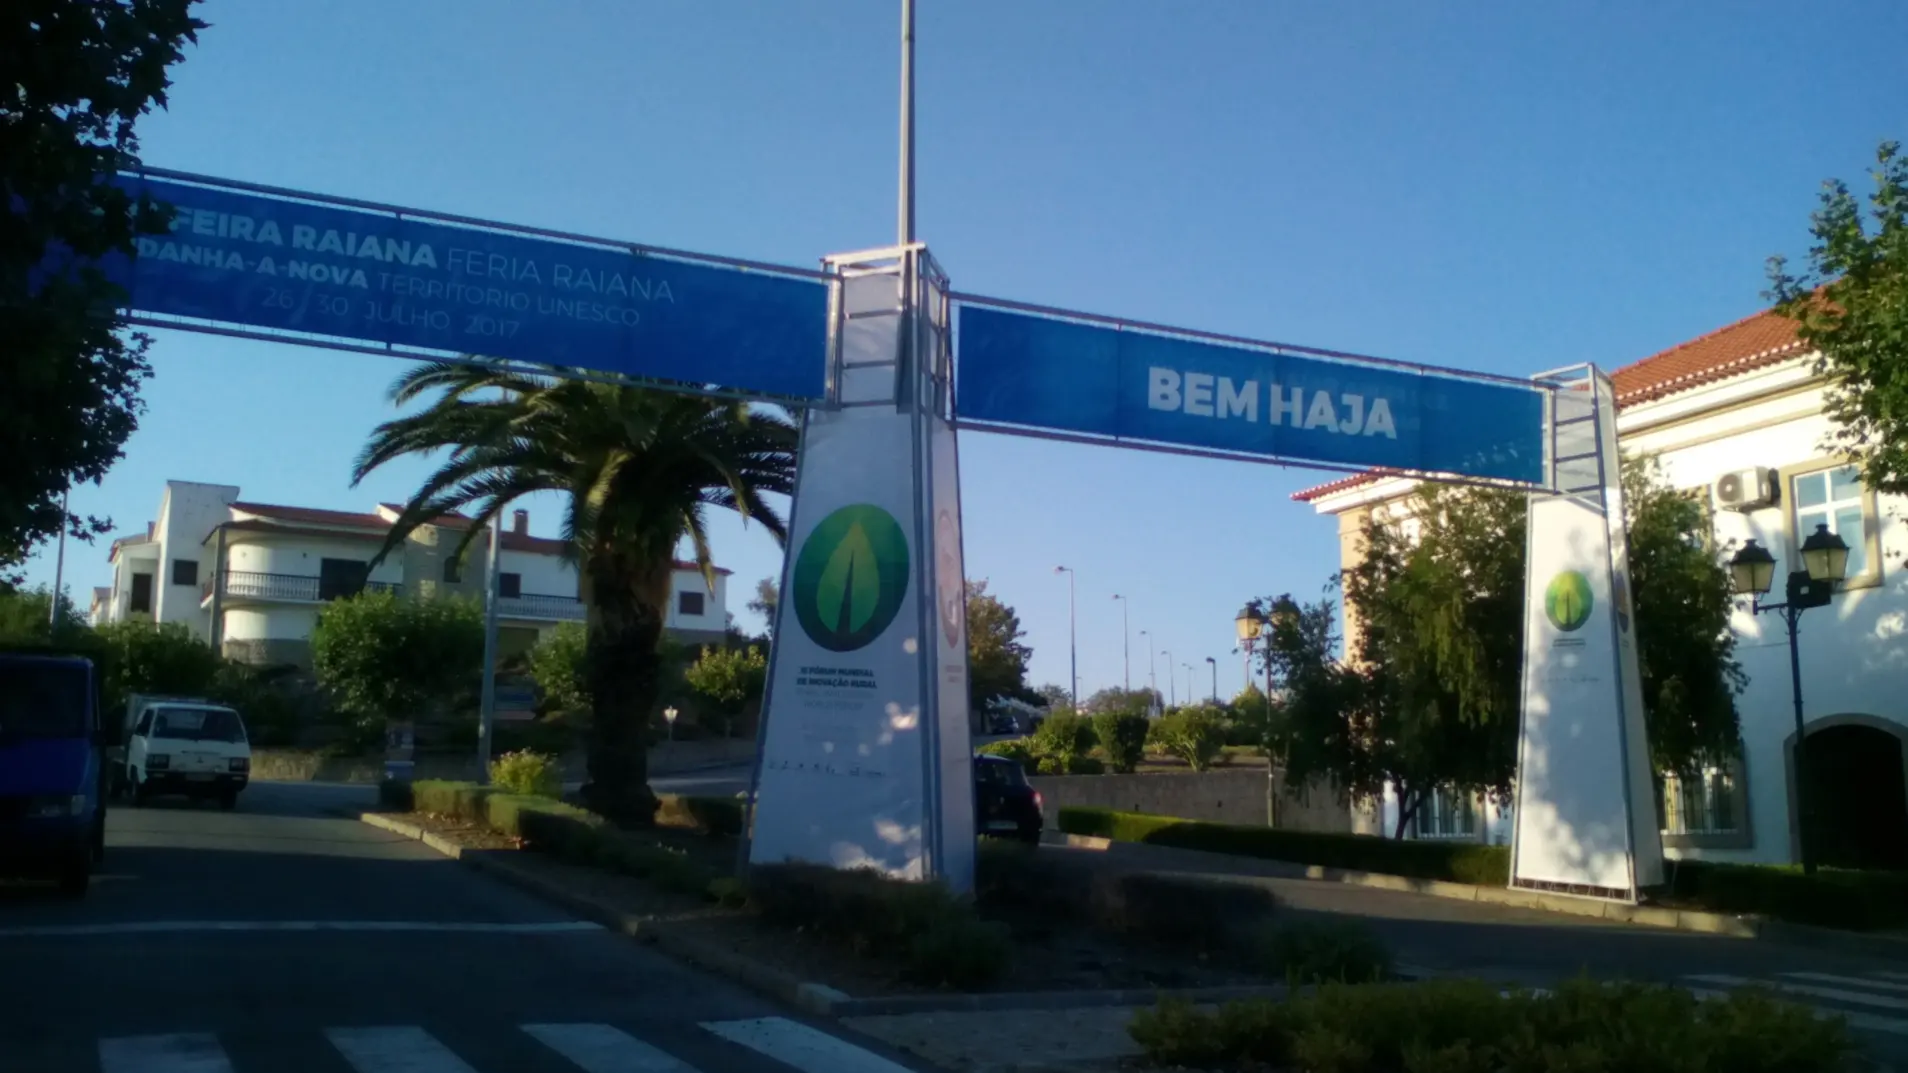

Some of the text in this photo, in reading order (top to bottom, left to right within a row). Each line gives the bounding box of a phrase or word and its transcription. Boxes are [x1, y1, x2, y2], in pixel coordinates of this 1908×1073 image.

[172, 205, 675, 305] FEIRA RAIANA FERIA RAIANA
[363, 300, 451, 330] JULHO
[463, 313, 520, 339] 2017
[378, 272, 530, 312] TERRITORIO
[537, 294, 640, 328] UNESCO
[1147, 366, 1398, 441] BEM HAJA
